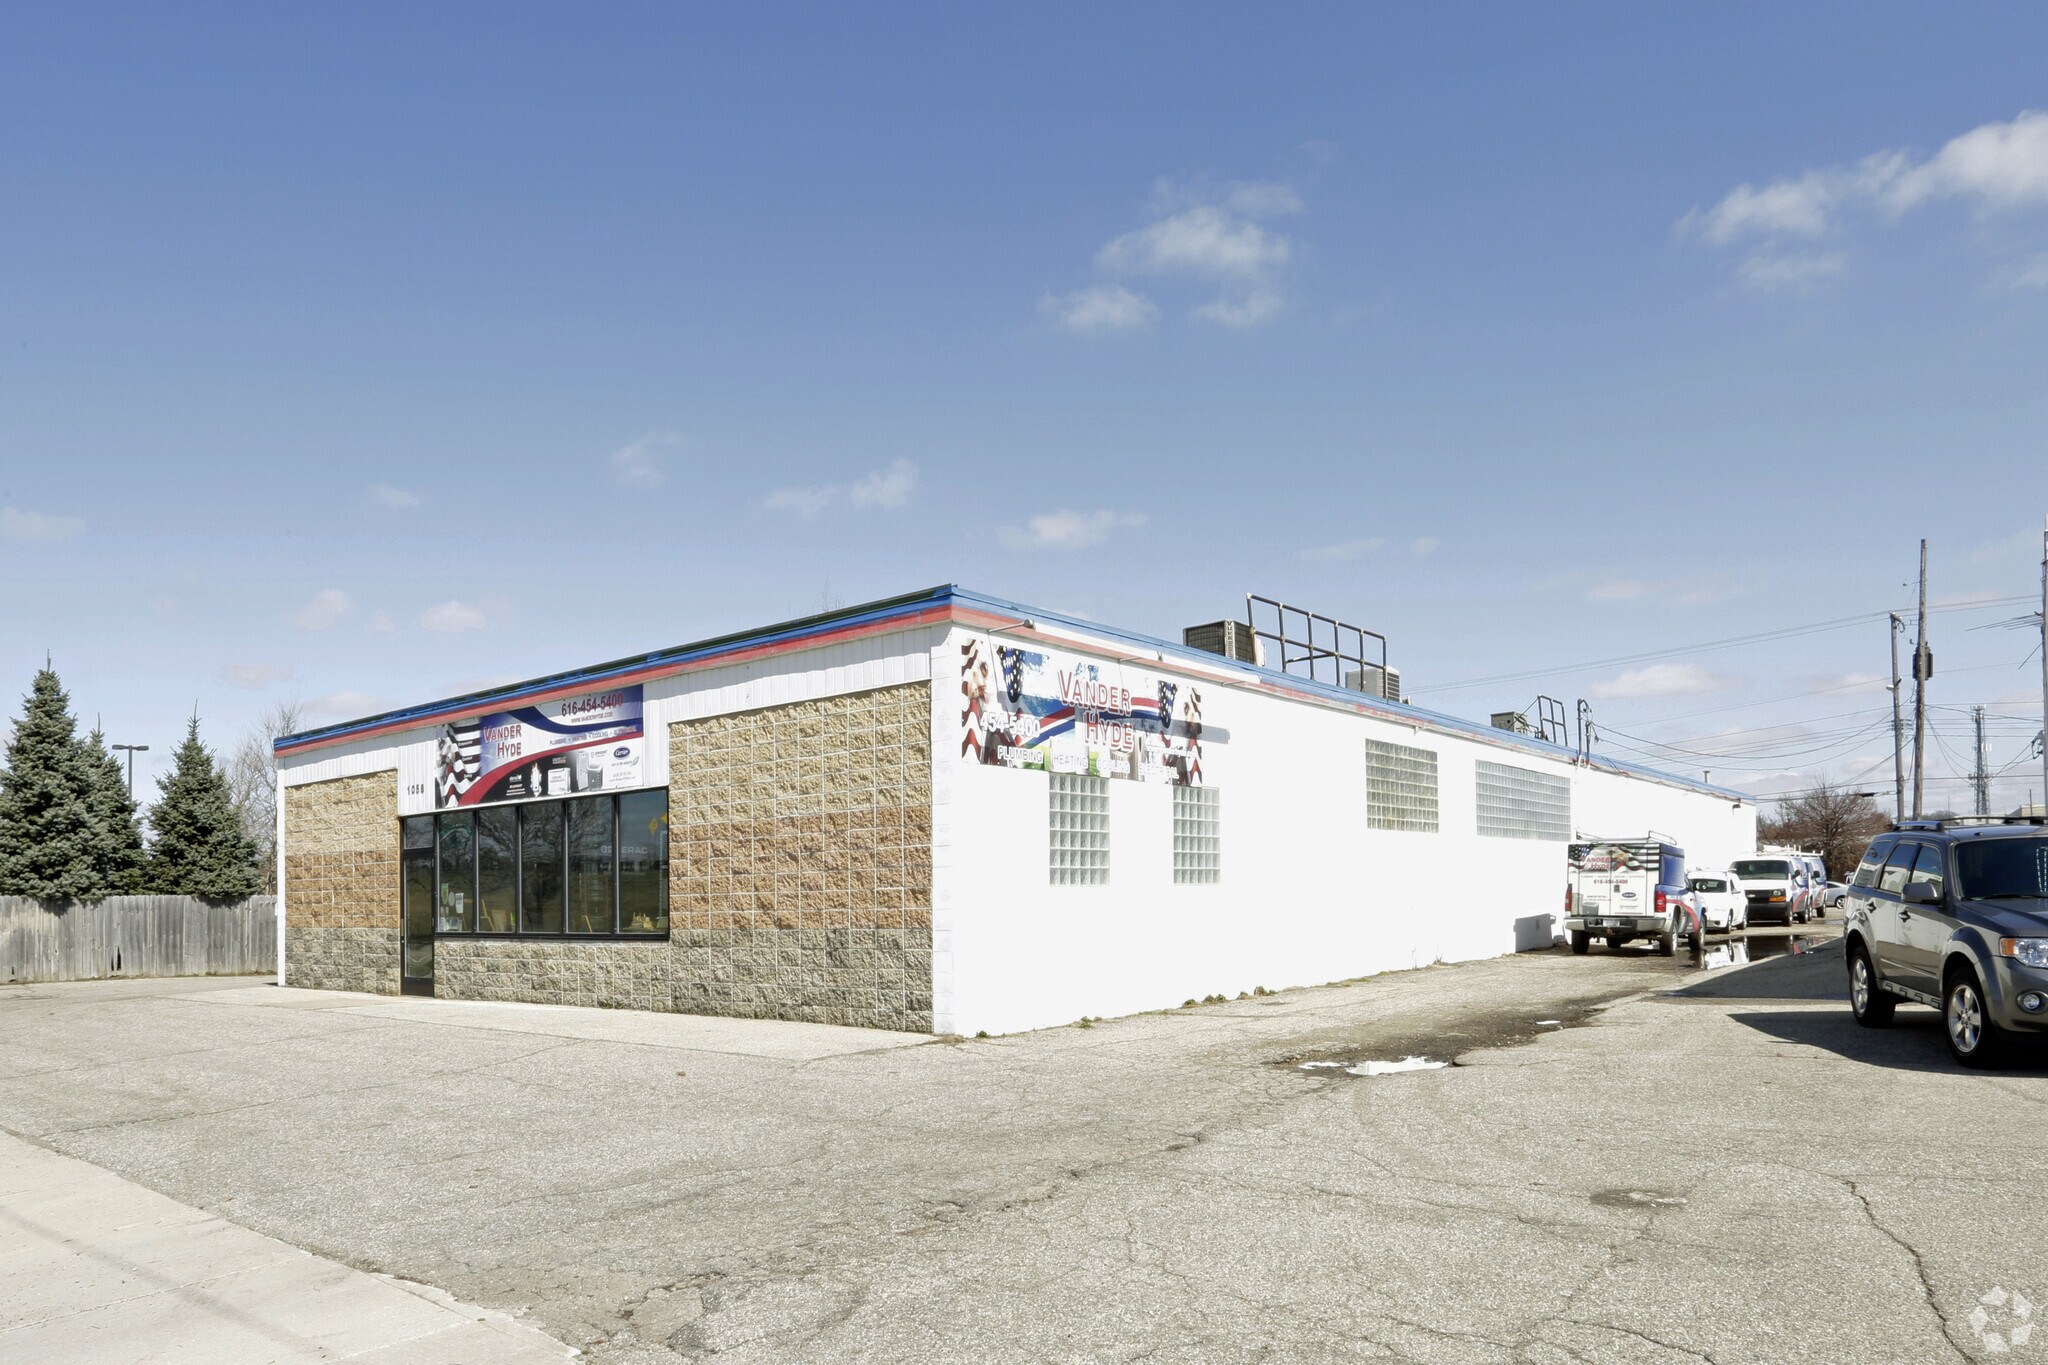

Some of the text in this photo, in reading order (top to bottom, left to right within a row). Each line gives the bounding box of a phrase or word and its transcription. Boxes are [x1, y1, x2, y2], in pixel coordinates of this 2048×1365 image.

[562, 692, 623, 716] 616-454-5400
[1058, 670, 1131, 716] VANDER
[483, 725, 522, 743] VANDER
[980, 712, 1040, 737] 454-5400
[1083, 711, 1133, 750] HYDE
[497, 742, 522, 758] HYDE
[998, 745, 1043, 763] PLUMBING
[1054, 754, 1088, 767] HEATING
